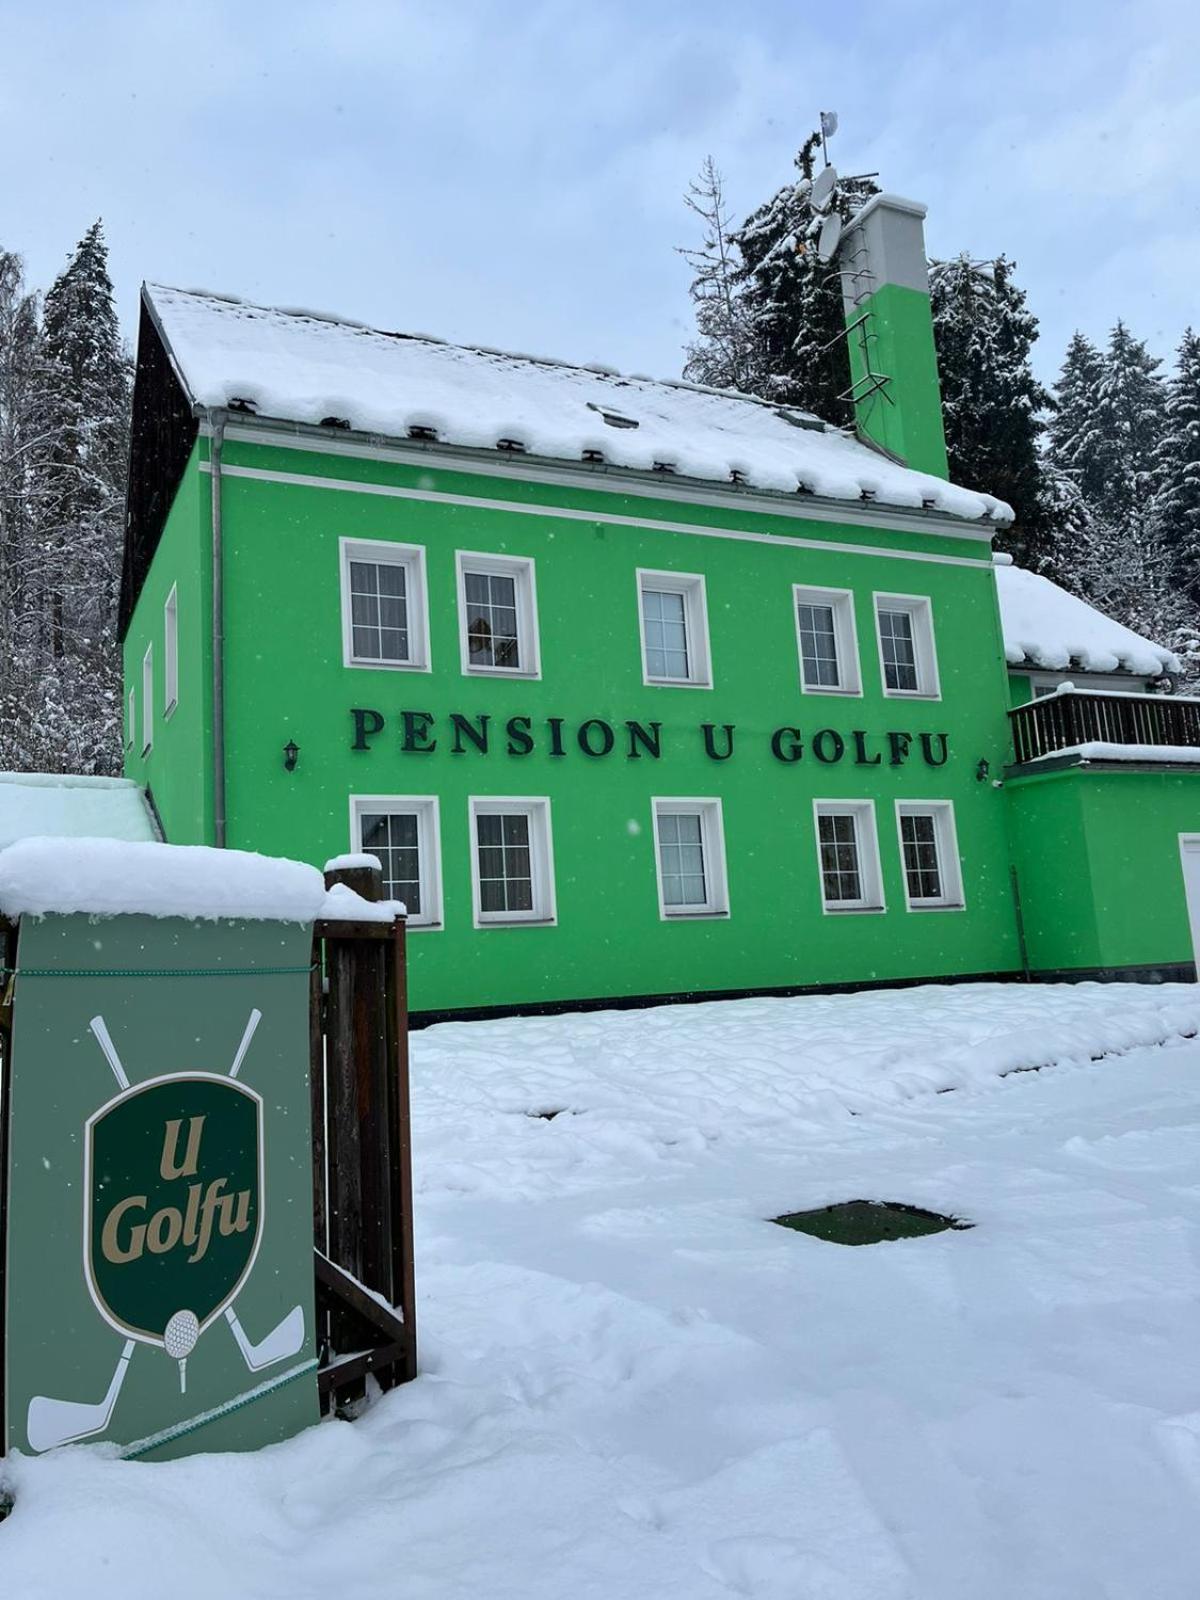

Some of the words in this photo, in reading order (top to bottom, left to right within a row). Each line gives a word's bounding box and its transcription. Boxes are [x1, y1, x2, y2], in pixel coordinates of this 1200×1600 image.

[350, 708, 663, 760] PENSION
[700, 724, 736, 760] U
[771, 726, 950, 767] GOLFU
[101, 1177, 251, 1265] Golfu
